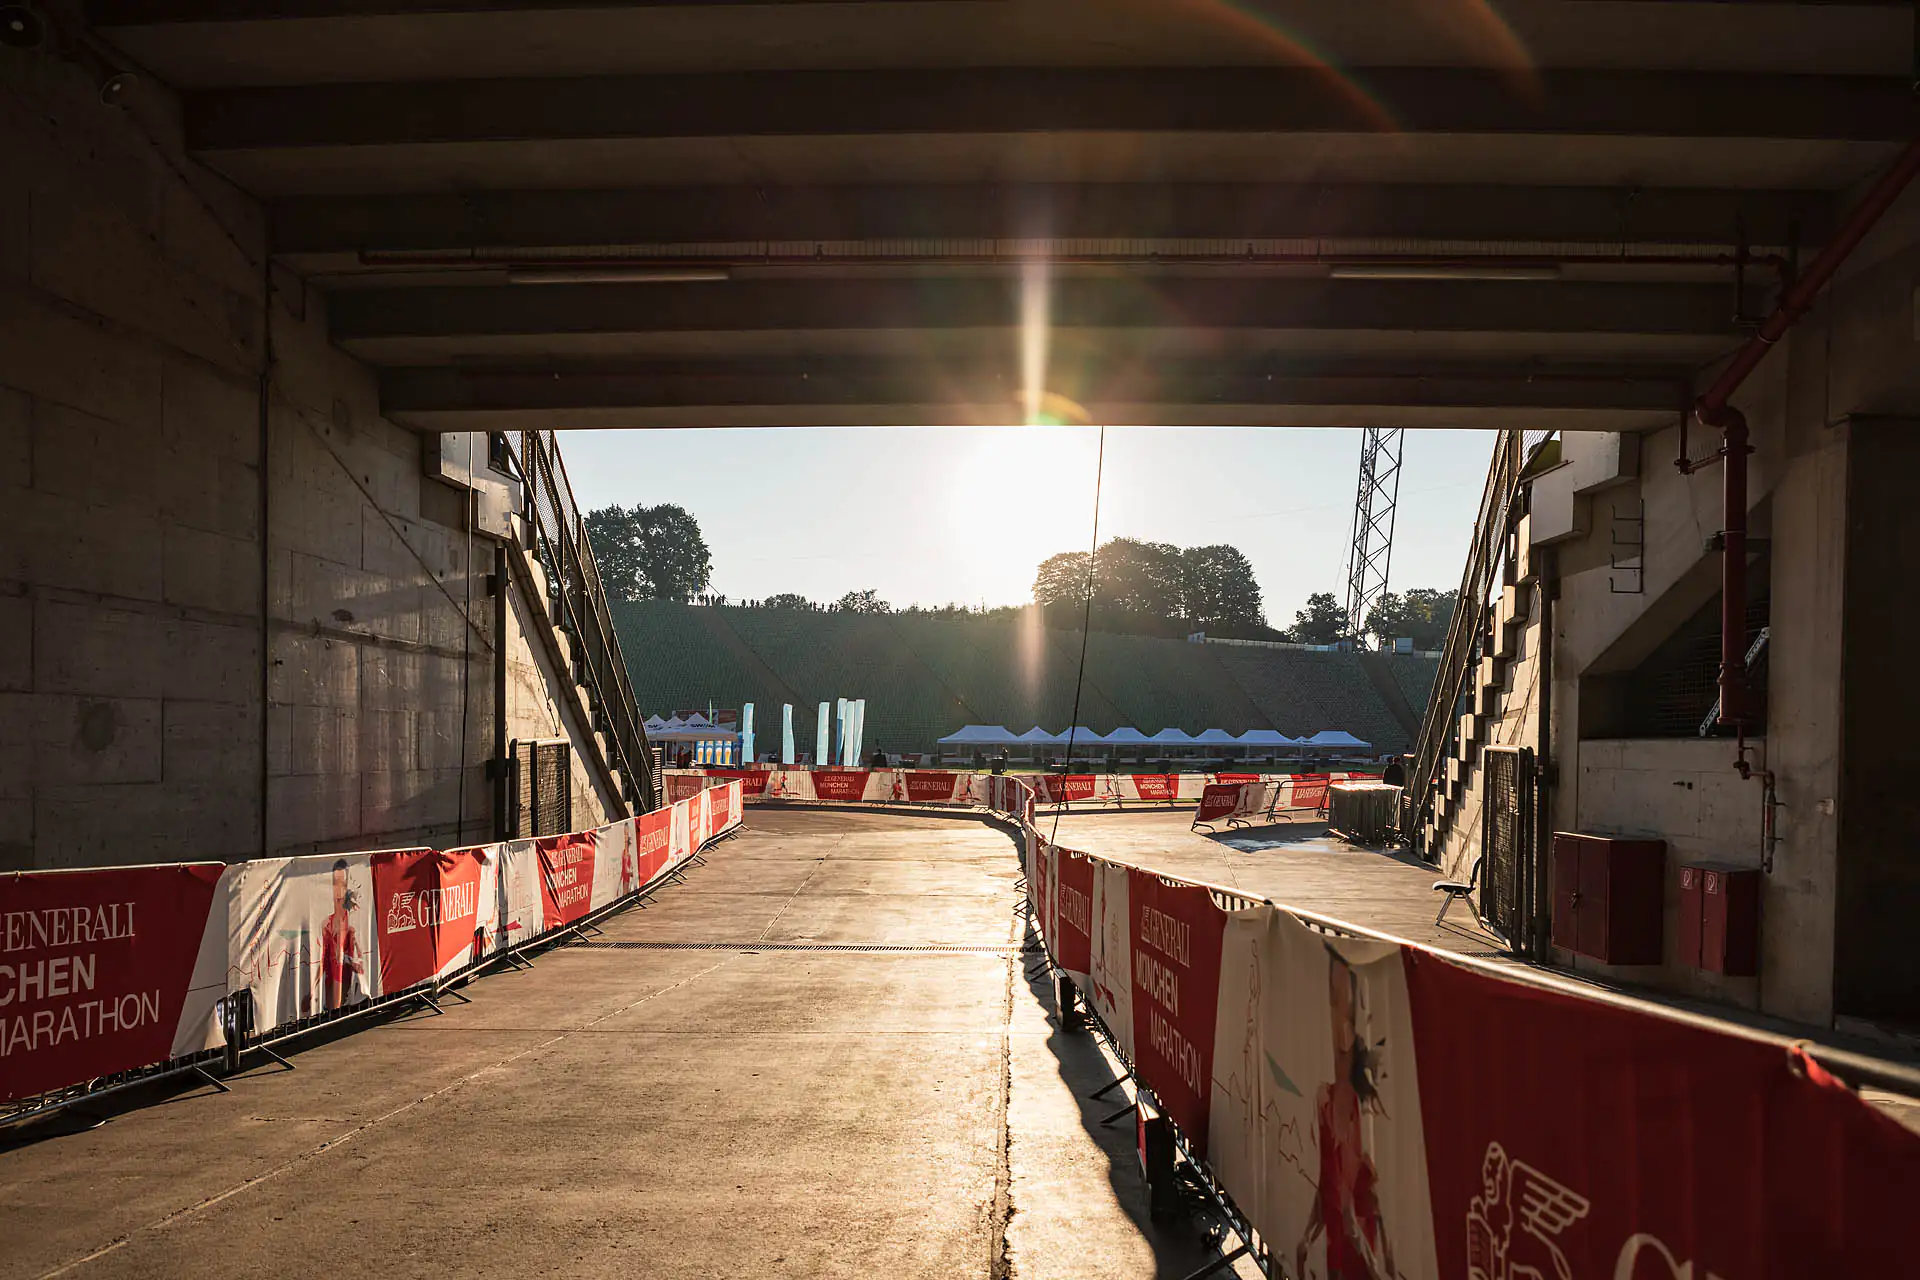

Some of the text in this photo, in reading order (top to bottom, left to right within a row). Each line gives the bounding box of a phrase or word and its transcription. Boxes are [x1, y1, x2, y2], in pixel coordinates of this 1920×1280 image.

[918, 780, 951, 792] GENERALI
[1058, 781, 1092, 792] GENERALI
[417, 881, 475, 928] GENERALI
[558, 882, 589, 909] MARATHON
[0, 902, 136, 953] ENERALI
[1149, 907, 1191, 969] GENERALI
[1150, 1005, 1202, 1099] MARATHON
